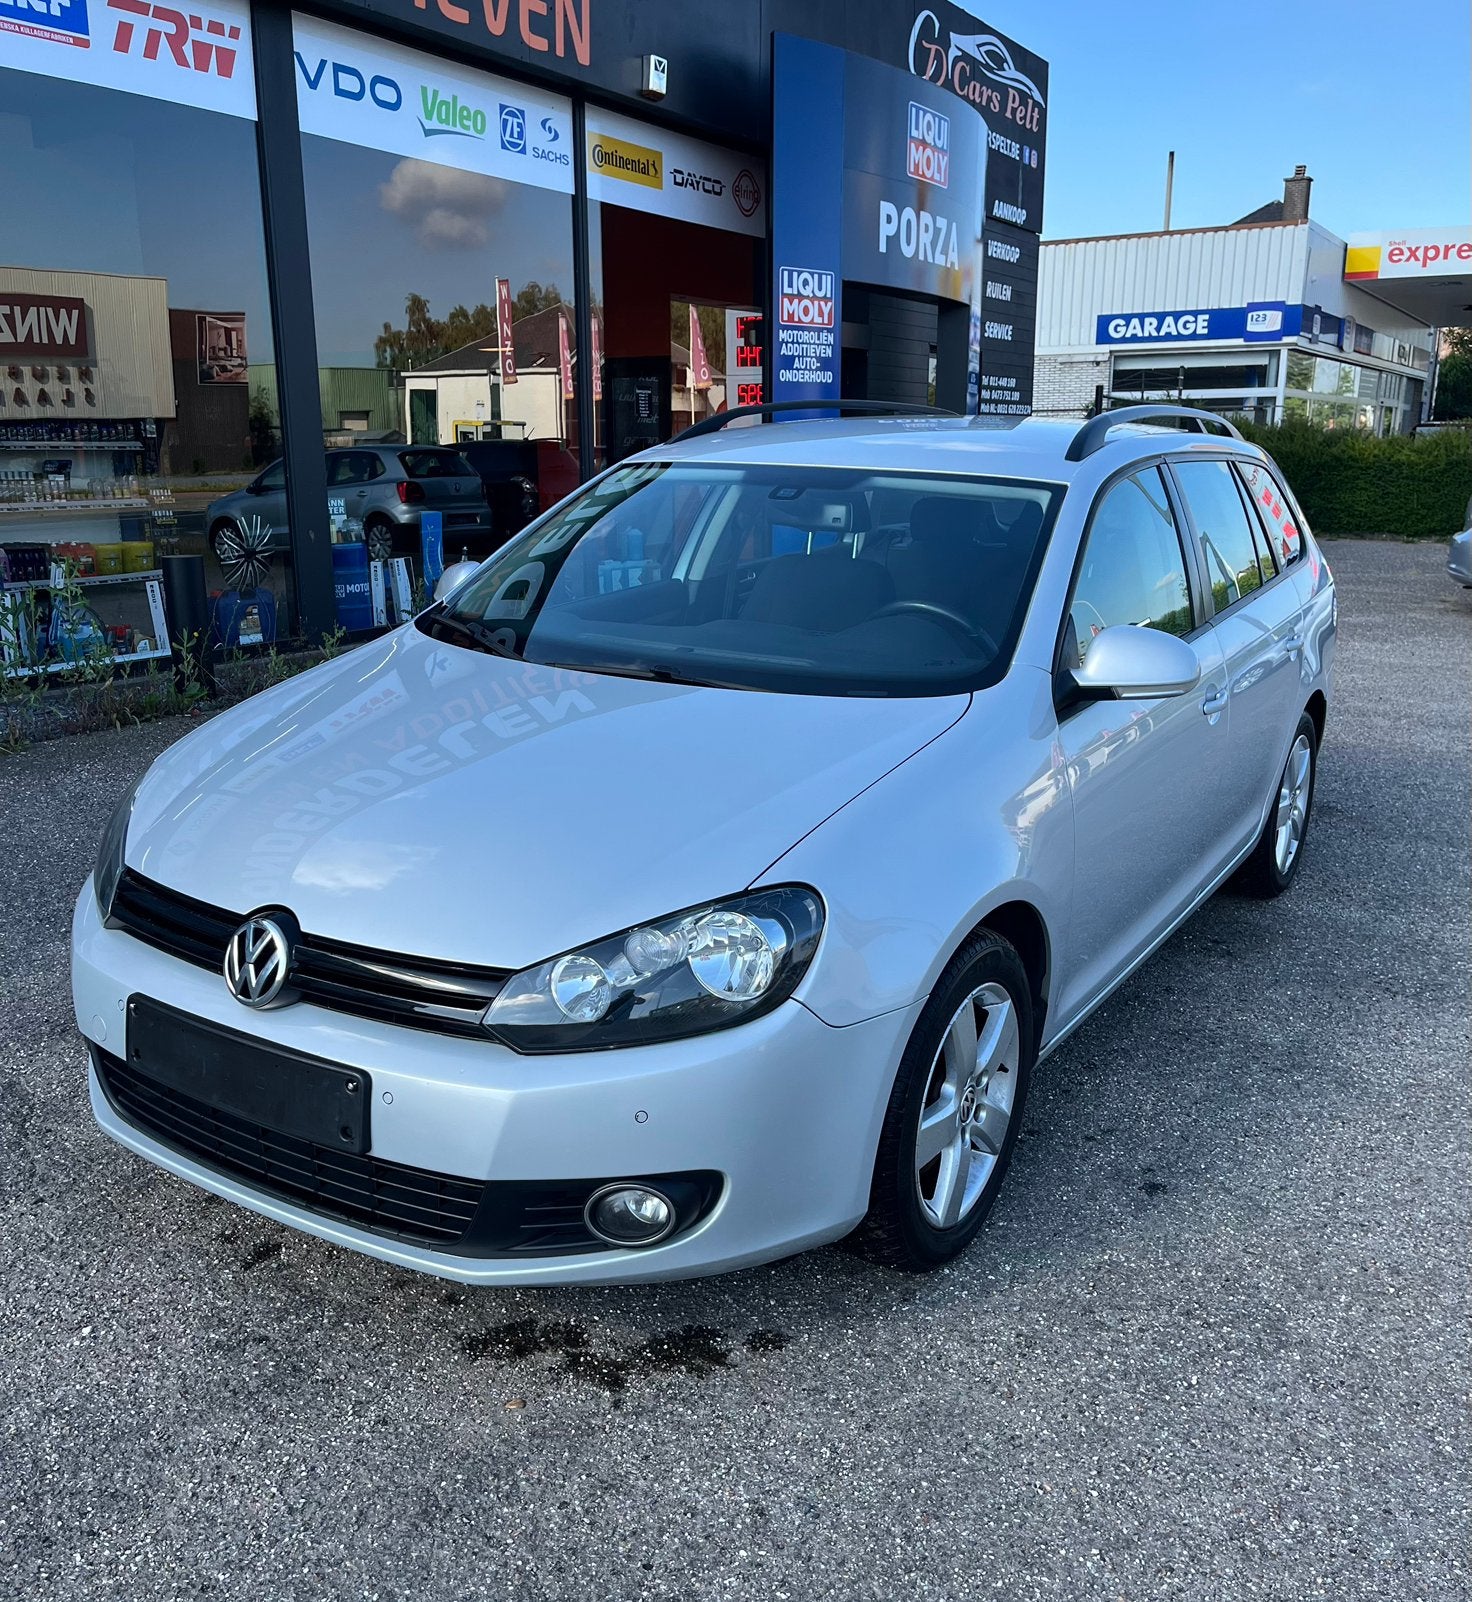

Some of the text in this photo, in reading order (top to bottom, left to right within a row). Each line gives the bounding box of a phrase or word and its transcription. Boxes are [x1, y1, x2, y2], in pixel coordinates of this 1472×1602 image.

[0, 21, 20, 32] ENSKA
[107, 0, 241, 79] TRW
[294, 51, 402, 112] VDO
[420, 85, 487, 135] Valeo
[953, 61, 1040, 133] Cars Pelt
[911, 106, 948, 150] LIQUI
[532, 147, 570, 166] SACHS
[592, 144, 650, 176] Continental
[909, 142, 948, 183] MOLY
[670, 168, 727, 197] DAYCO
[992, 199, 1027, 225] AANKOOP
[879, 200, 959, 270] PORZA
[1388, 239, 1407, 247] Shell
[987, 239, 1020, 264] VERKOOP
[1387, 242, 1472, 268] expre
[783, 270, 832, 298] LIQUI
[986, 281, 1012, 302] RUILEN
[783, 297, 833, 324] MOLY
[1250, 313, 1268, 322] 123
[779, 329, 834, 345] MOTOROLIËN
[984, 321, 1013, 341] SERVICE
[1108, 314, 1209, 338] GARAGE
[780, 343, 833, 357] ADDITIEVEN
[793, 357, 821, 369] AUTO-
[779, 369, 833, 383] ONDERHOUD
